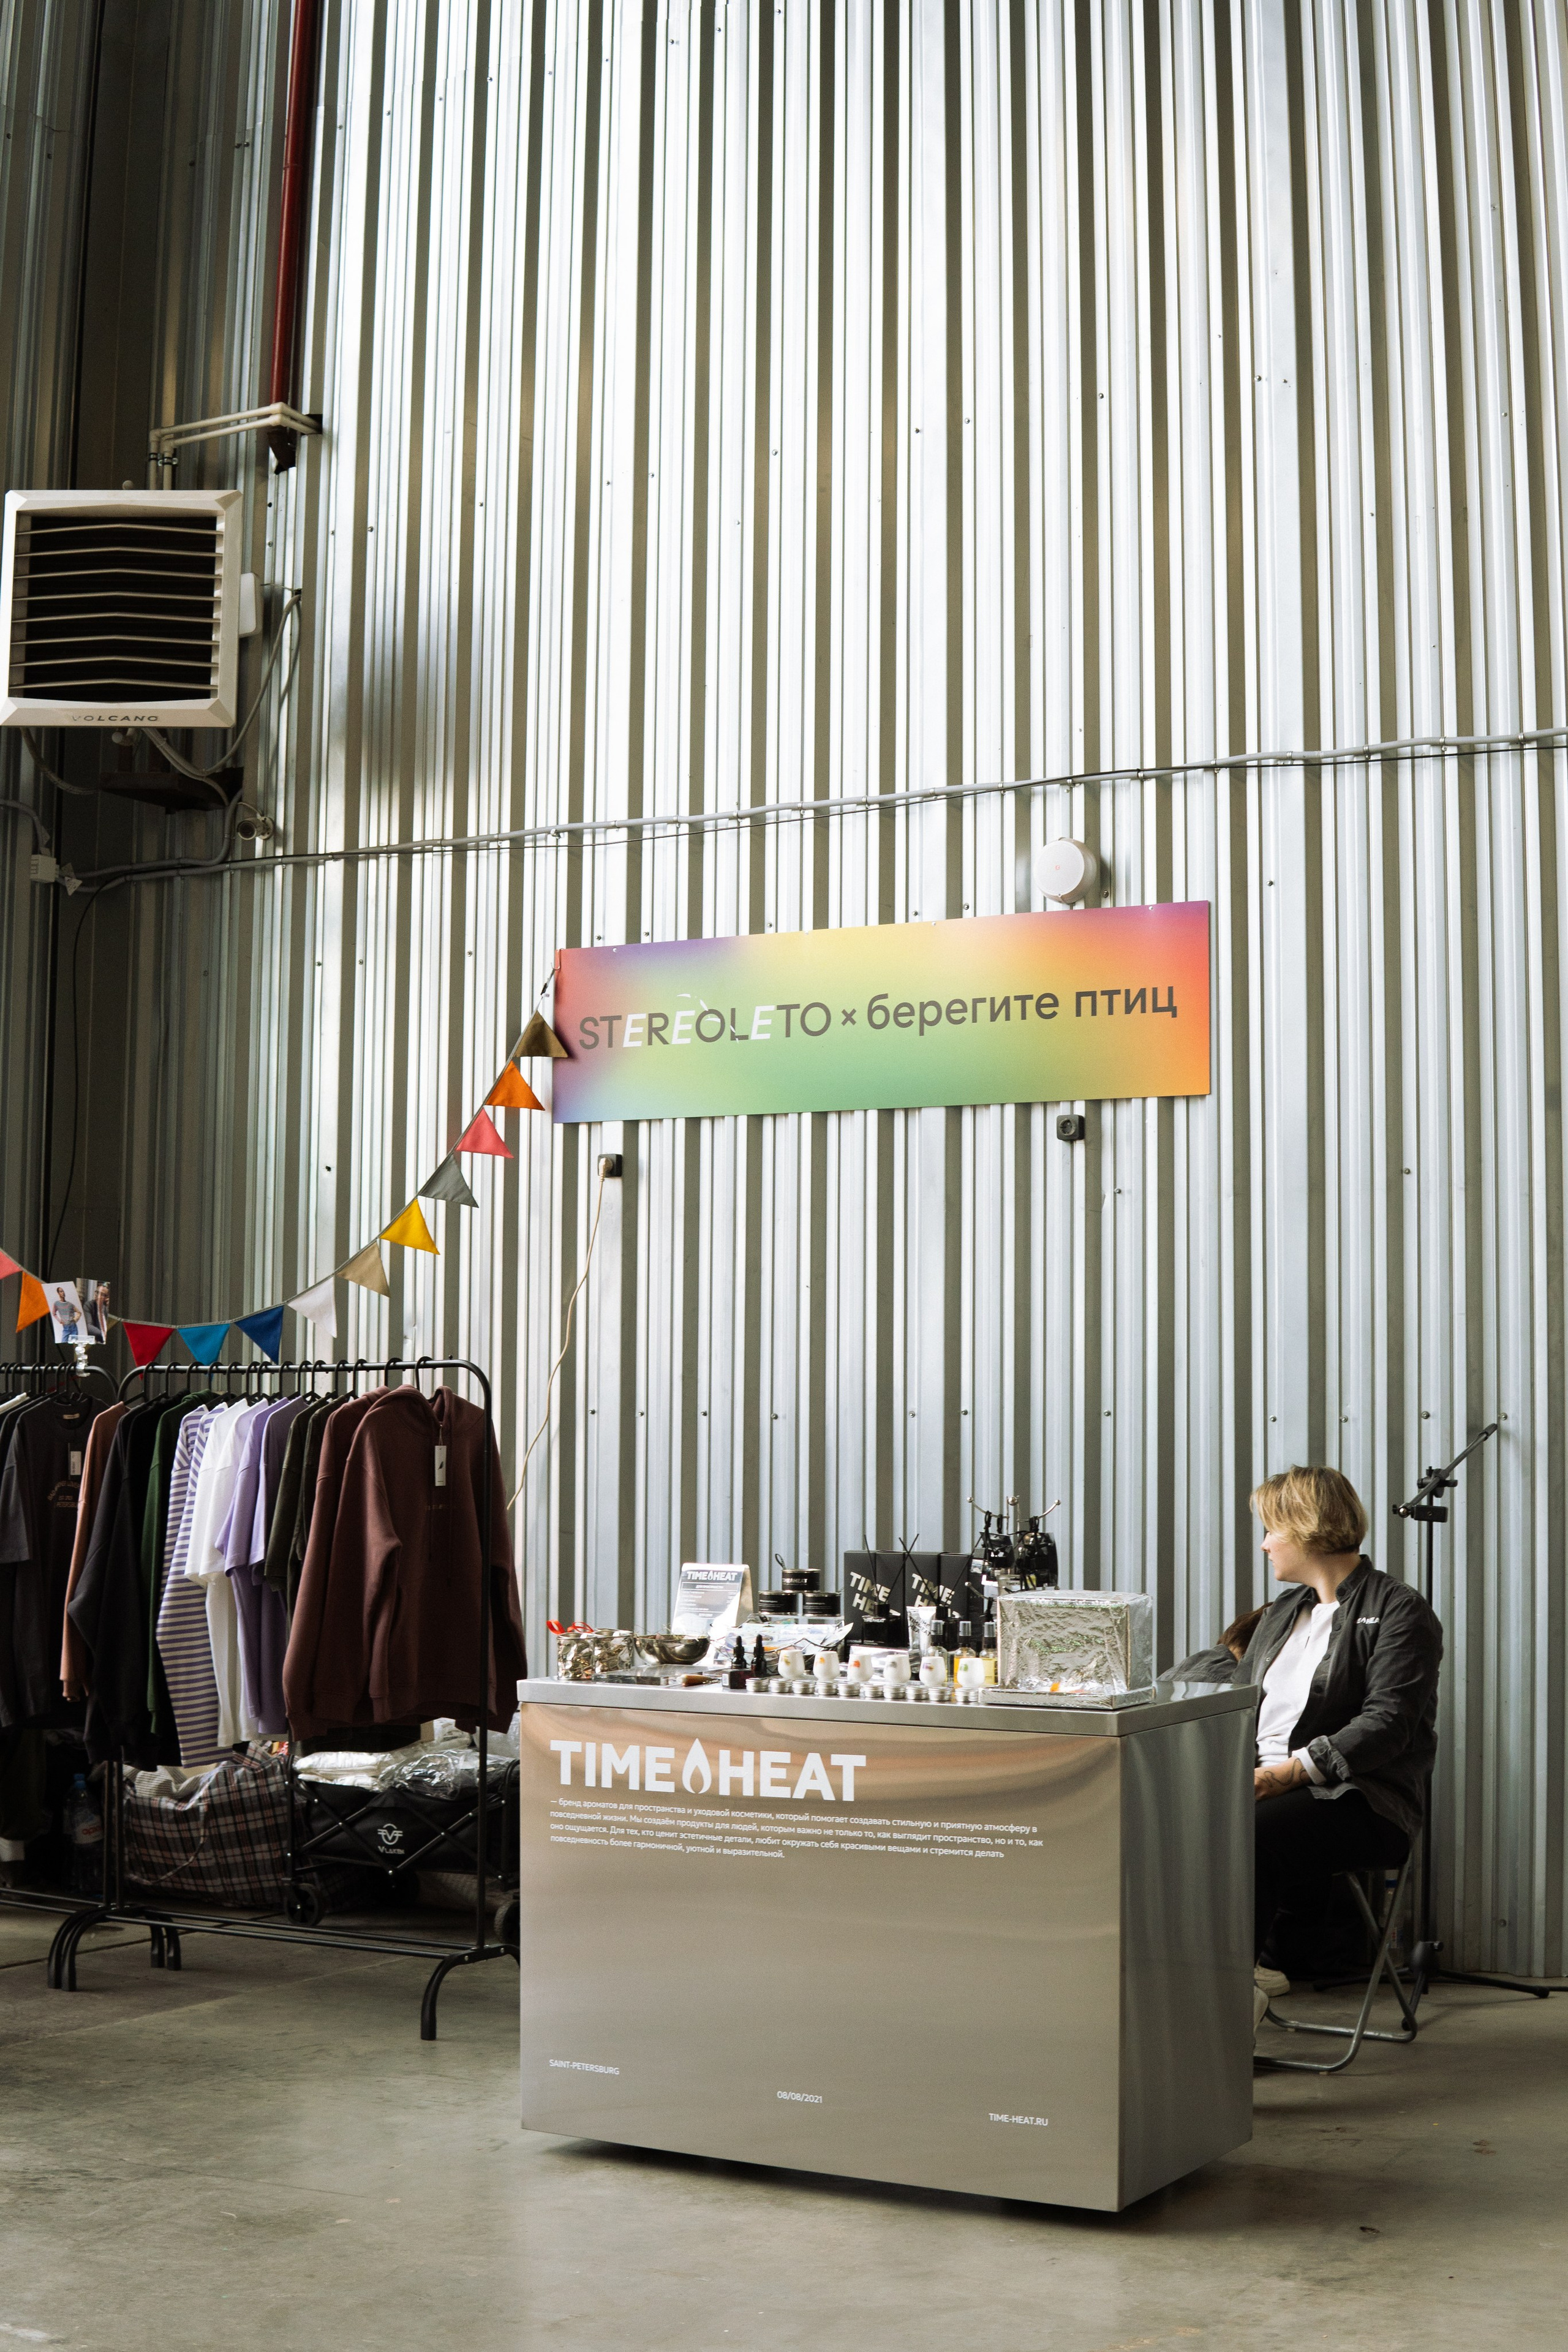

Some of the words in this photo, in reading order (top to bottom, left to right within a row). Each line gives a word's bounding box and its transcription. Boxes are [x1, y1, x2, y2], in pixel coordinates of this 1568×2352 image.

[867, 992, 1060, 1036] берегите
[1075, 986, 1178, 1018] птиц
[687, 1571, 708, 1580] TIME
[713, 1572, 737, 1581] HEAT
[850, 1571, 891, 1602] TIME
[911, 1573, 955, 1605] TIME
[550, 1740, 675, 1792] TIME
[718, 1749, 867, 1801] HEAT
[550, 1811, 601, 1820] повседневной
[630, 1814, 643, 1823] Мы
[676, 1820, 714, 1829] продукты
[731, 1822, 760, 1832] людей,
[760, 1825, 796, 1834] которым
[834, 1829, 863, 1838] только
[892, 1832, 932, 1842] выглядит
[933, 1834, 993, 1845] пространство,
[559, 1798, 582, 1807] бренд
[582, 1801, 617, 1809] ароматов
[635, 1804, 686, 1814] пространства
[693, 1808, 730, 1817] уходовой
[731, 1811, 774, 1820] косметики,
[775, 1812, 810, 1822] который
[811, 1815, 848, 1823] помогает
[849, 1817, 891, 1826] создавать
[892, 1819, 932, 1830] стильную
[940, 1822, 983, 1832] приятную
[984, 1823, 1031, 1834] атмосферу
[551, 1836, 609, 1845] повседневность
[609, 1838, 632, 1847] более
[633, 1841, 685, 1852] гармоничной,
[685, 1845, 715, 1853] уютной
[722, 1848, 785, 1858] выразительной.
[564, 1824, 609, 1833] ощущается.
[609, 1825, 625, 1835] Для
[679, 1833, 723, 1842] эстетичные
[723, 1836, 754, 1844] детали,
[755, 1836, 781, 1845] любит
[781, 1839, 820, 1848] окружать
[820, 1840, 840, 1849] себя
[840, 1842, 886, 1851] красивыми
[887, 1845, 922, 1854] вещами
[929, 1847, 974, 1856] стремится
[974, 1850, 1005, 1858] делать
[549, 2059, 620, 2075] SAINT-PETERSBURG
[777, 2090, 823, 2103] 08/08/2021
[989, 2113, 1049, 2127] TIME-HEAT.RU
